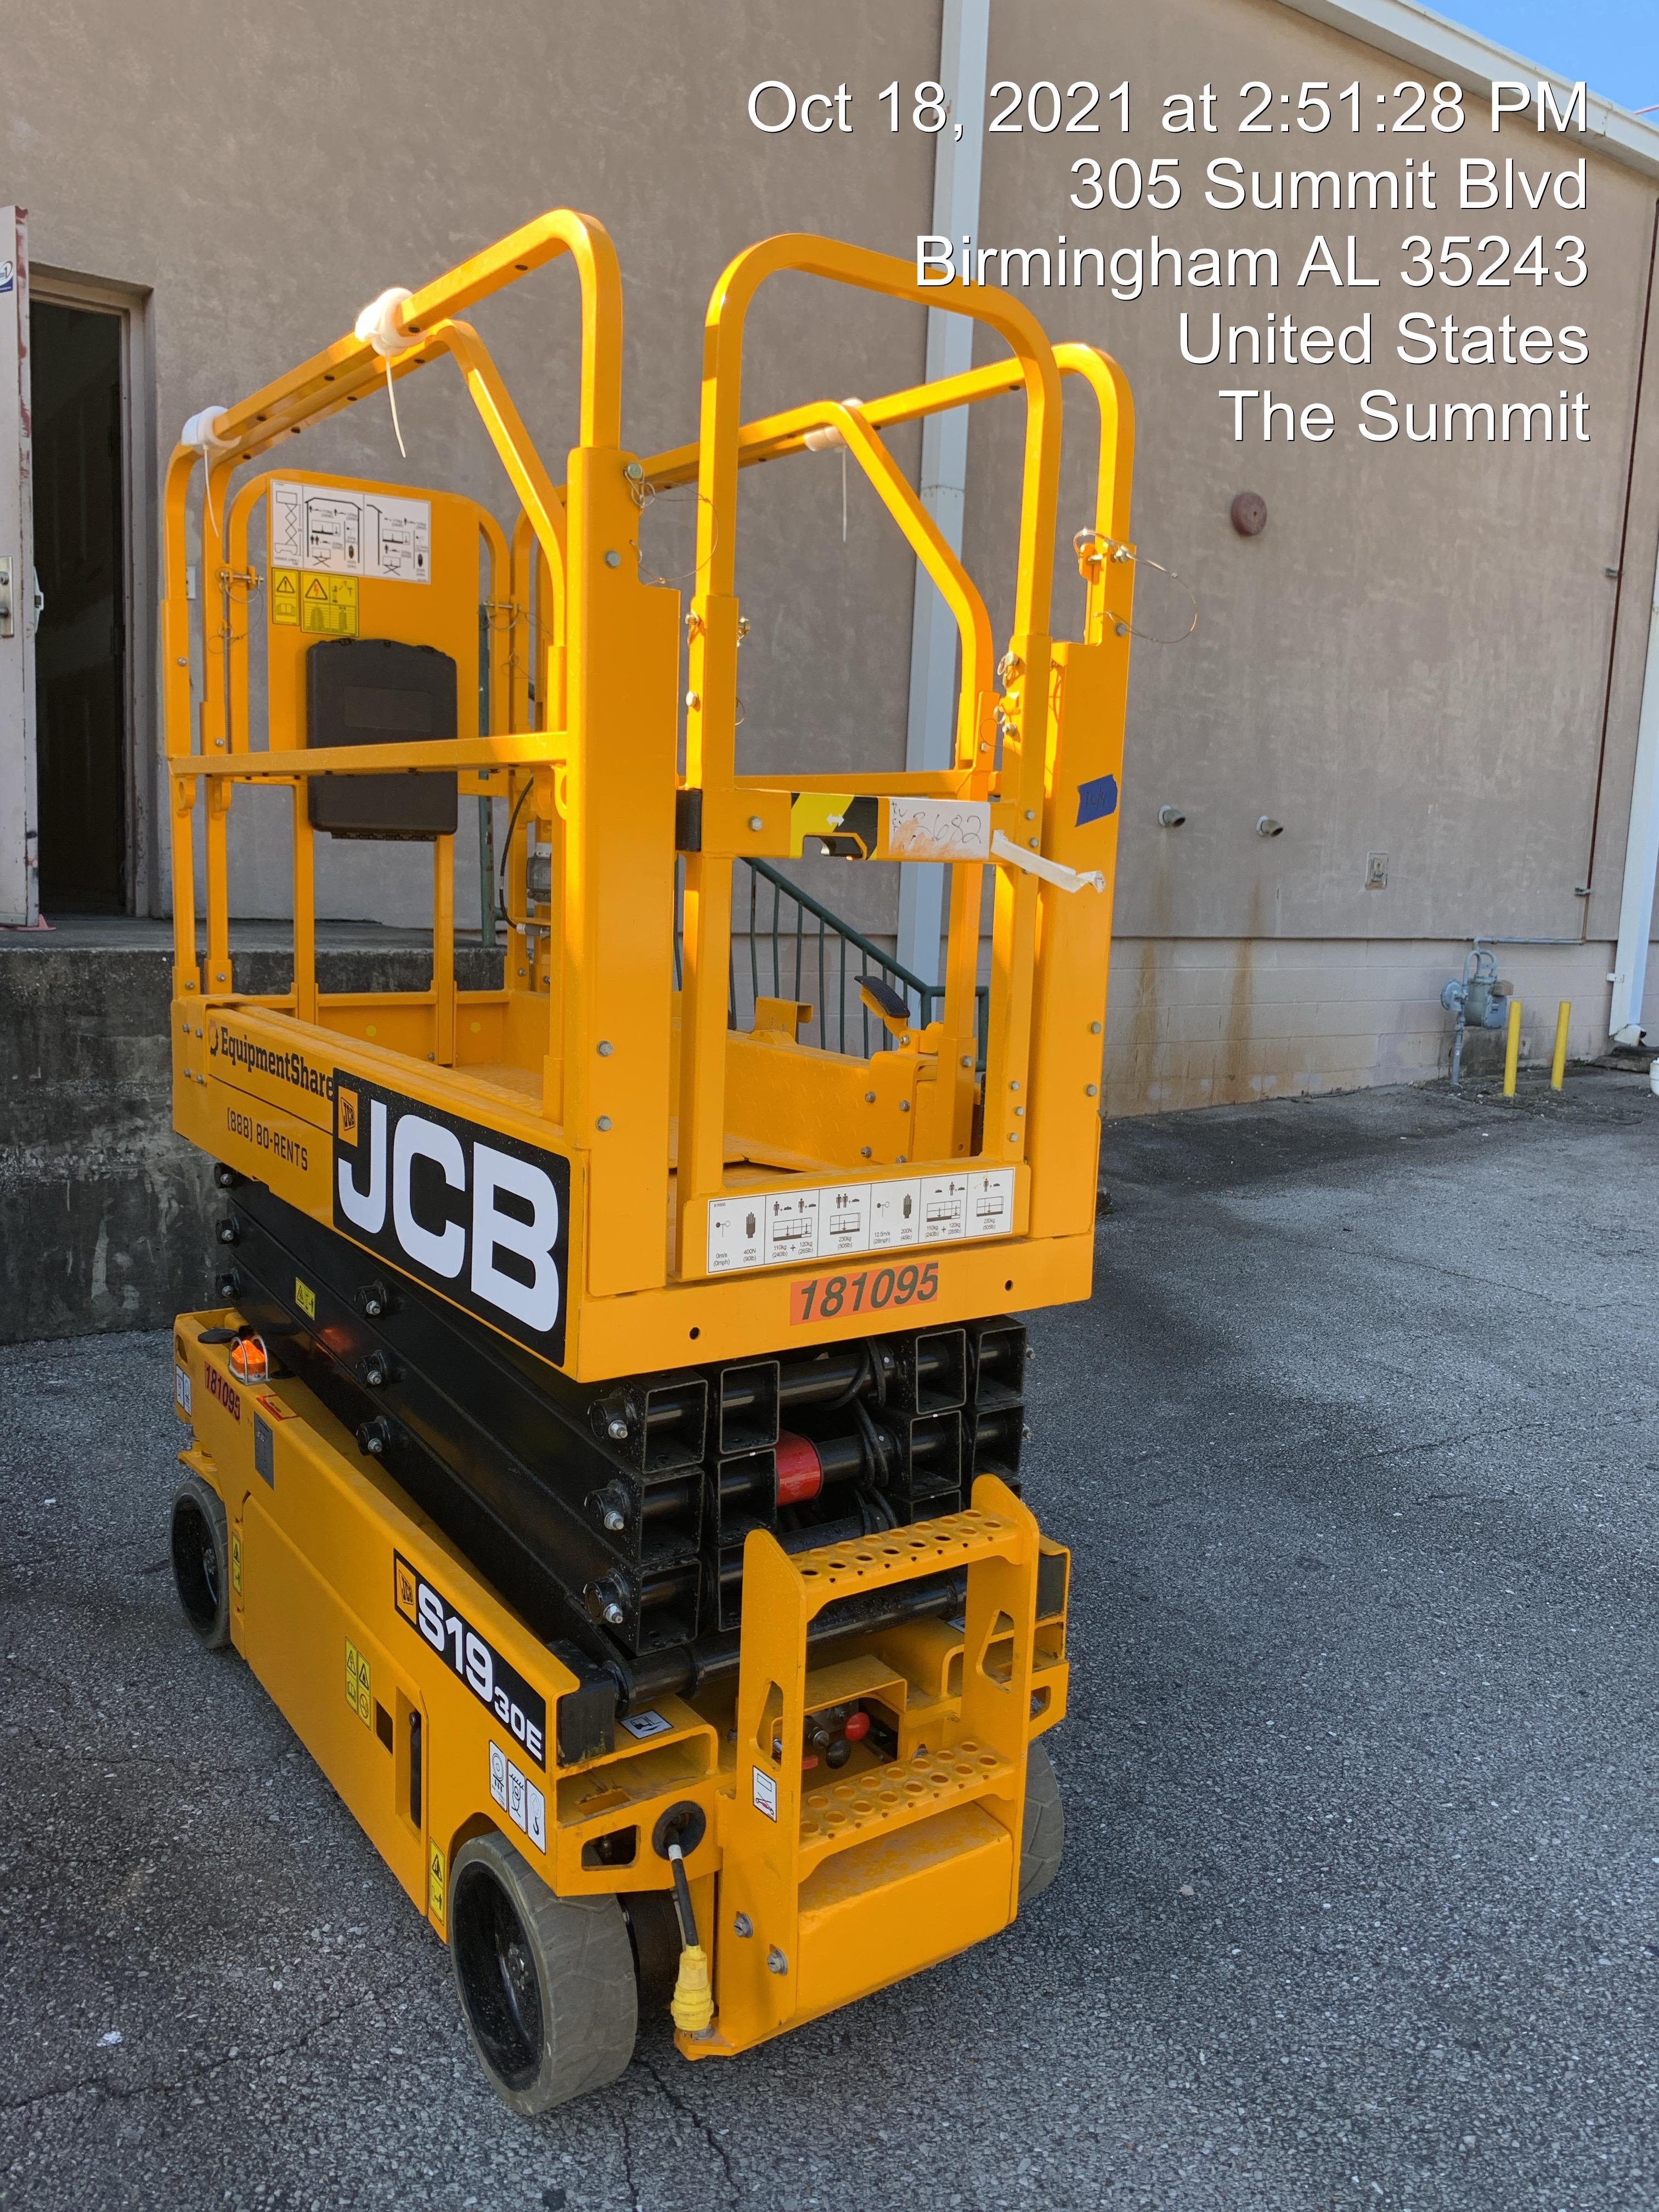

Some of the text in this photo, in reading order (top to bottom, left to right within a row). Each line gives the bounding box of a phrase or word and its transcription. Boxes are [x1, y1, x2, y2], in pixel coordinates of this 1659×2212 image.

[221, 1026, 335, 1102] EquipmentShare
[343, 1101, 356, 1130] JCB
[227, 1106, 308, 1171] (888) 80-RENTS
[338, 1099, 559, 1332] JCB
[838, 1236, 852, 1244] 230kg
[873, 1237, 890, 1245] (28mph)
[925, 1231, 939, 1239] (240lb)
[713, 1259, 730, 1267] (0mph)
[772, 1248, 814, 1259] (240lb) (265lb)
[800, 1262, 939, 1321] 181095
[205, 1364, 240, 1421] 181095
